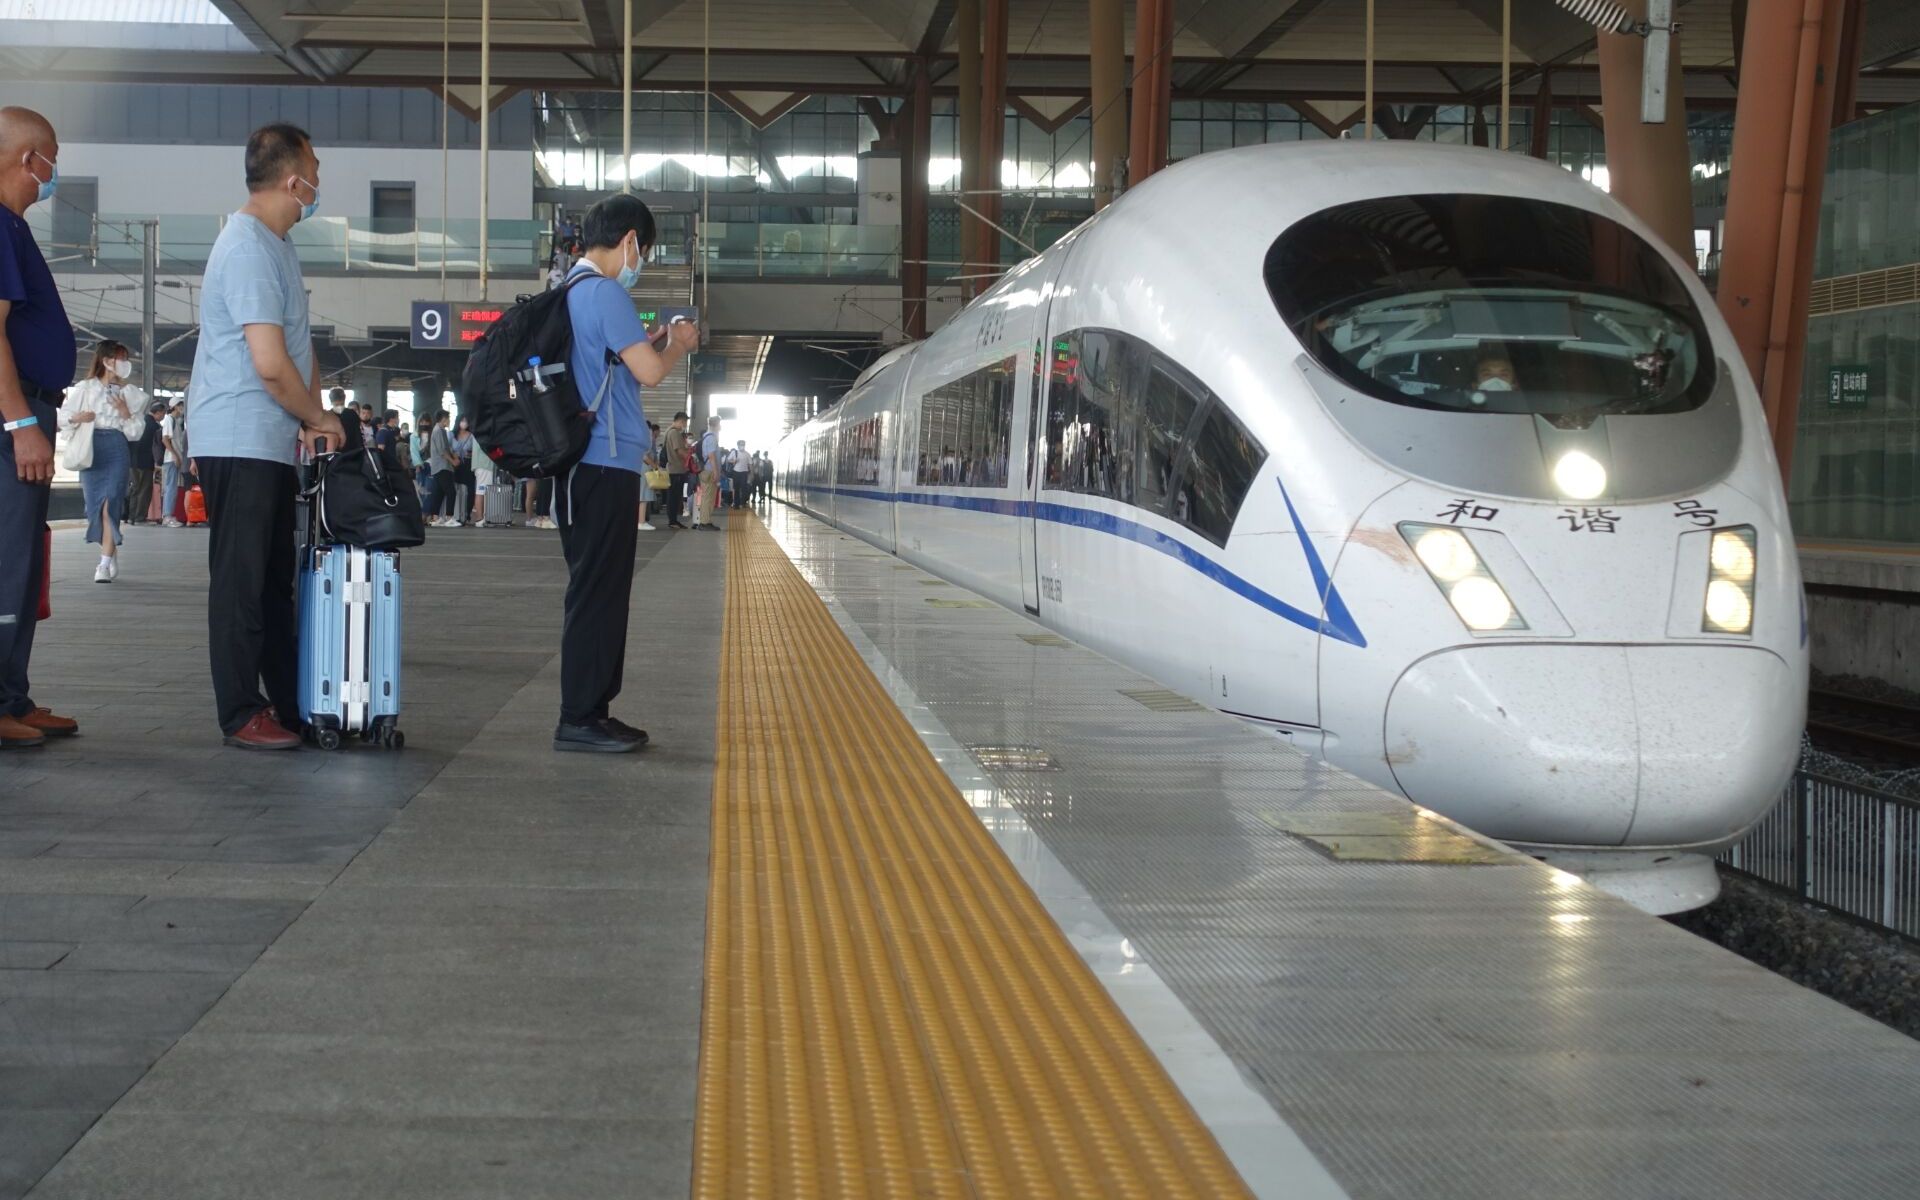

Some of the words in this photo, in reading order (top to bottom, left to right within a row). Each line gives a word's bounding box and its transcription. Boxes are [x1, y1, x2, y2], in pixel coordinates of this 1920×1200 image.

[420, 309, 442, 341] 9
[1437, 498, 1719, 534] 和谐号
